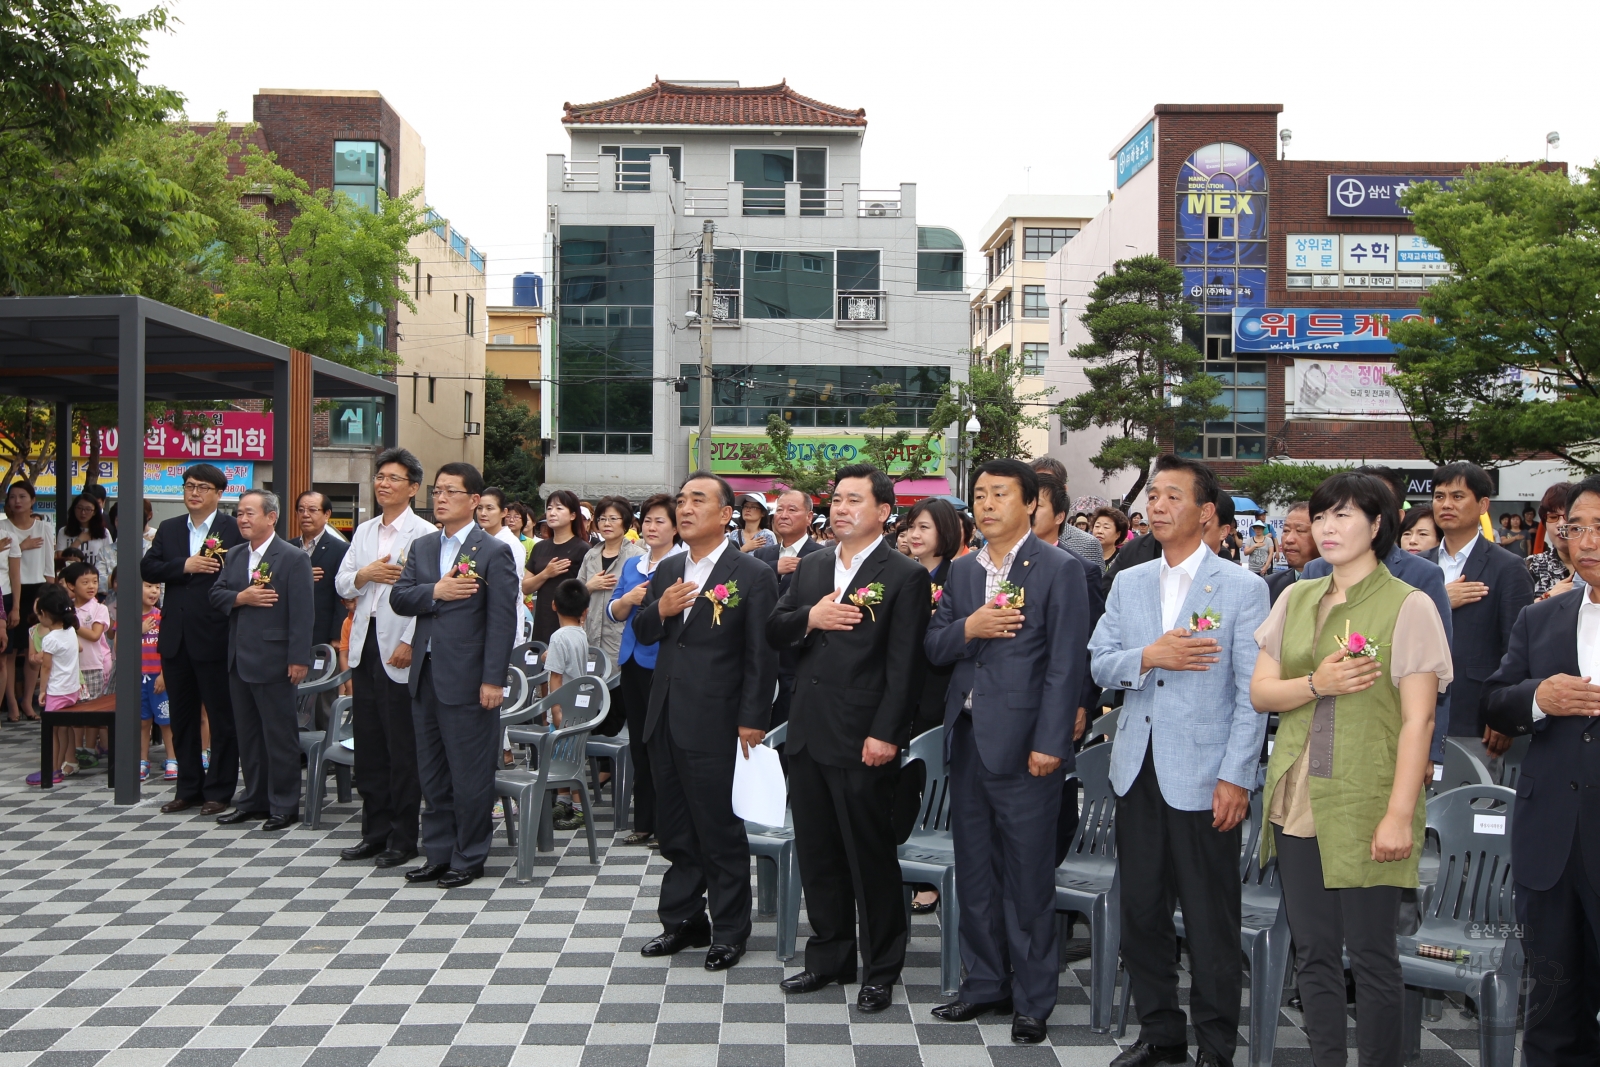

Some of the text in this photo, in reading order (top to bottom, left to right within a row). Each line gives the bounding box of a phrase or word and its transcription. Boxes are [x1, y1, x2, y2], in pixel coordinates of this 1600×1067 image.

[1367, 185, 1391, 199] 삼신
[1187, 190, 1253, 215] MEX
[1295, 238, 1333, 251] 상위권
[1350, 242, 1390, 264] 수학
[1270, 339, 1340, 351] with came
[785, 441, 858, 462] BINGO
